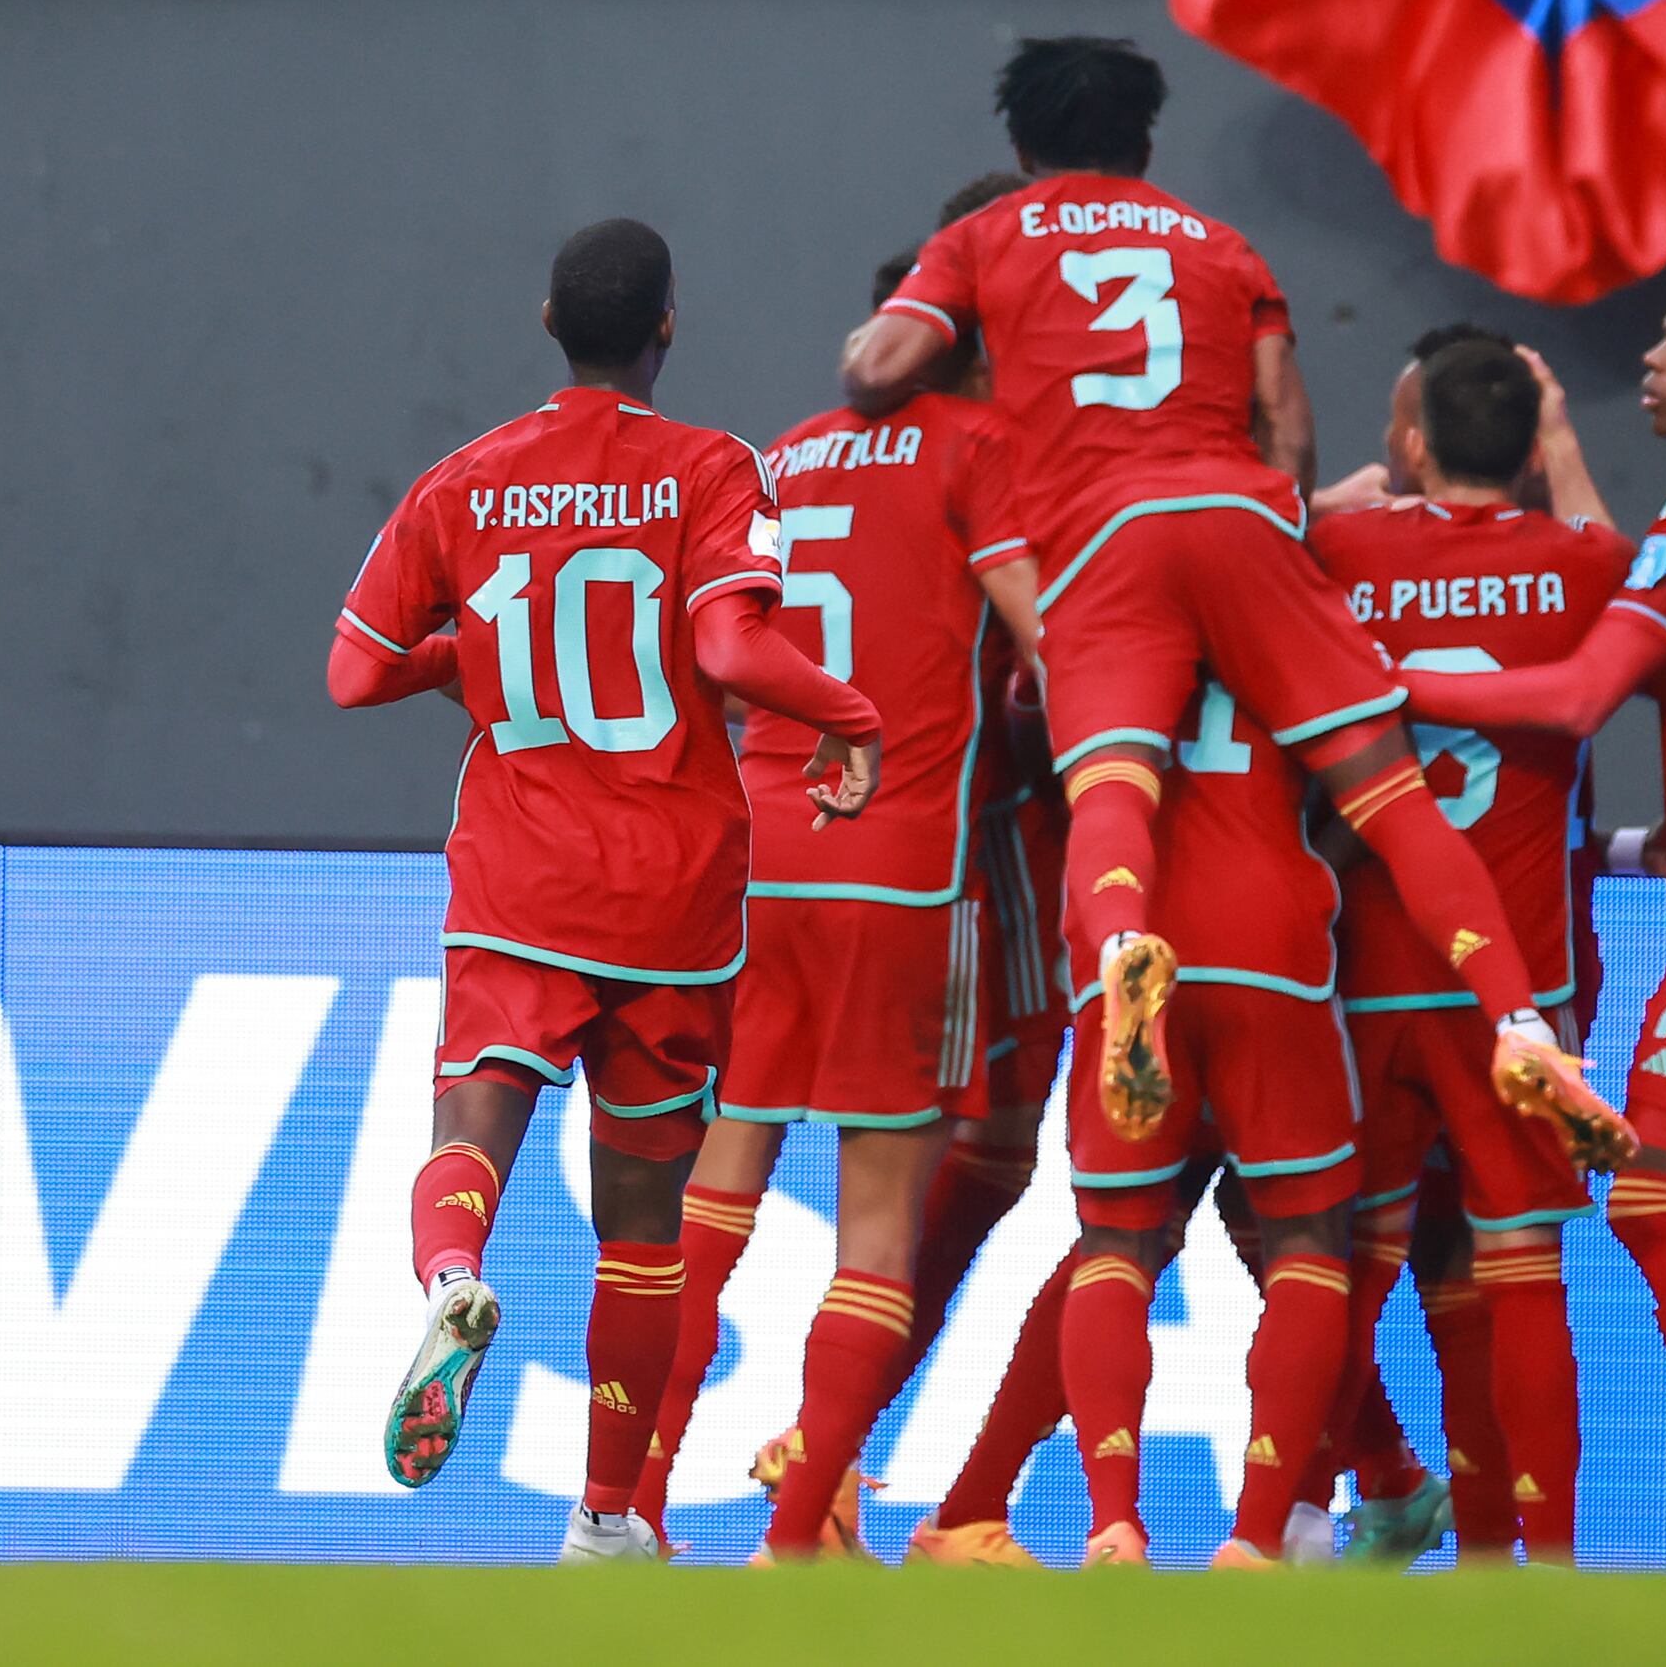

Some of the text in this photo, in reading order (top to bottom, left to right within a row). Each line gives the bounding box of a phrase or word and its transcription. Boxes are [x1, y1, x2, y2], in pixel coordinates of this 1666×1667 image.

[1020, 201, 1207, 241] E.OCAMPO
[1060, 248, 1183, 410] 3
[469, 476, 679, 531] Y.ASPRILLA
[781, 504, 855, 684] 5
[1351, 571, 1566, 623] G.PUERTA
[466, 548, 678, 755] 10
